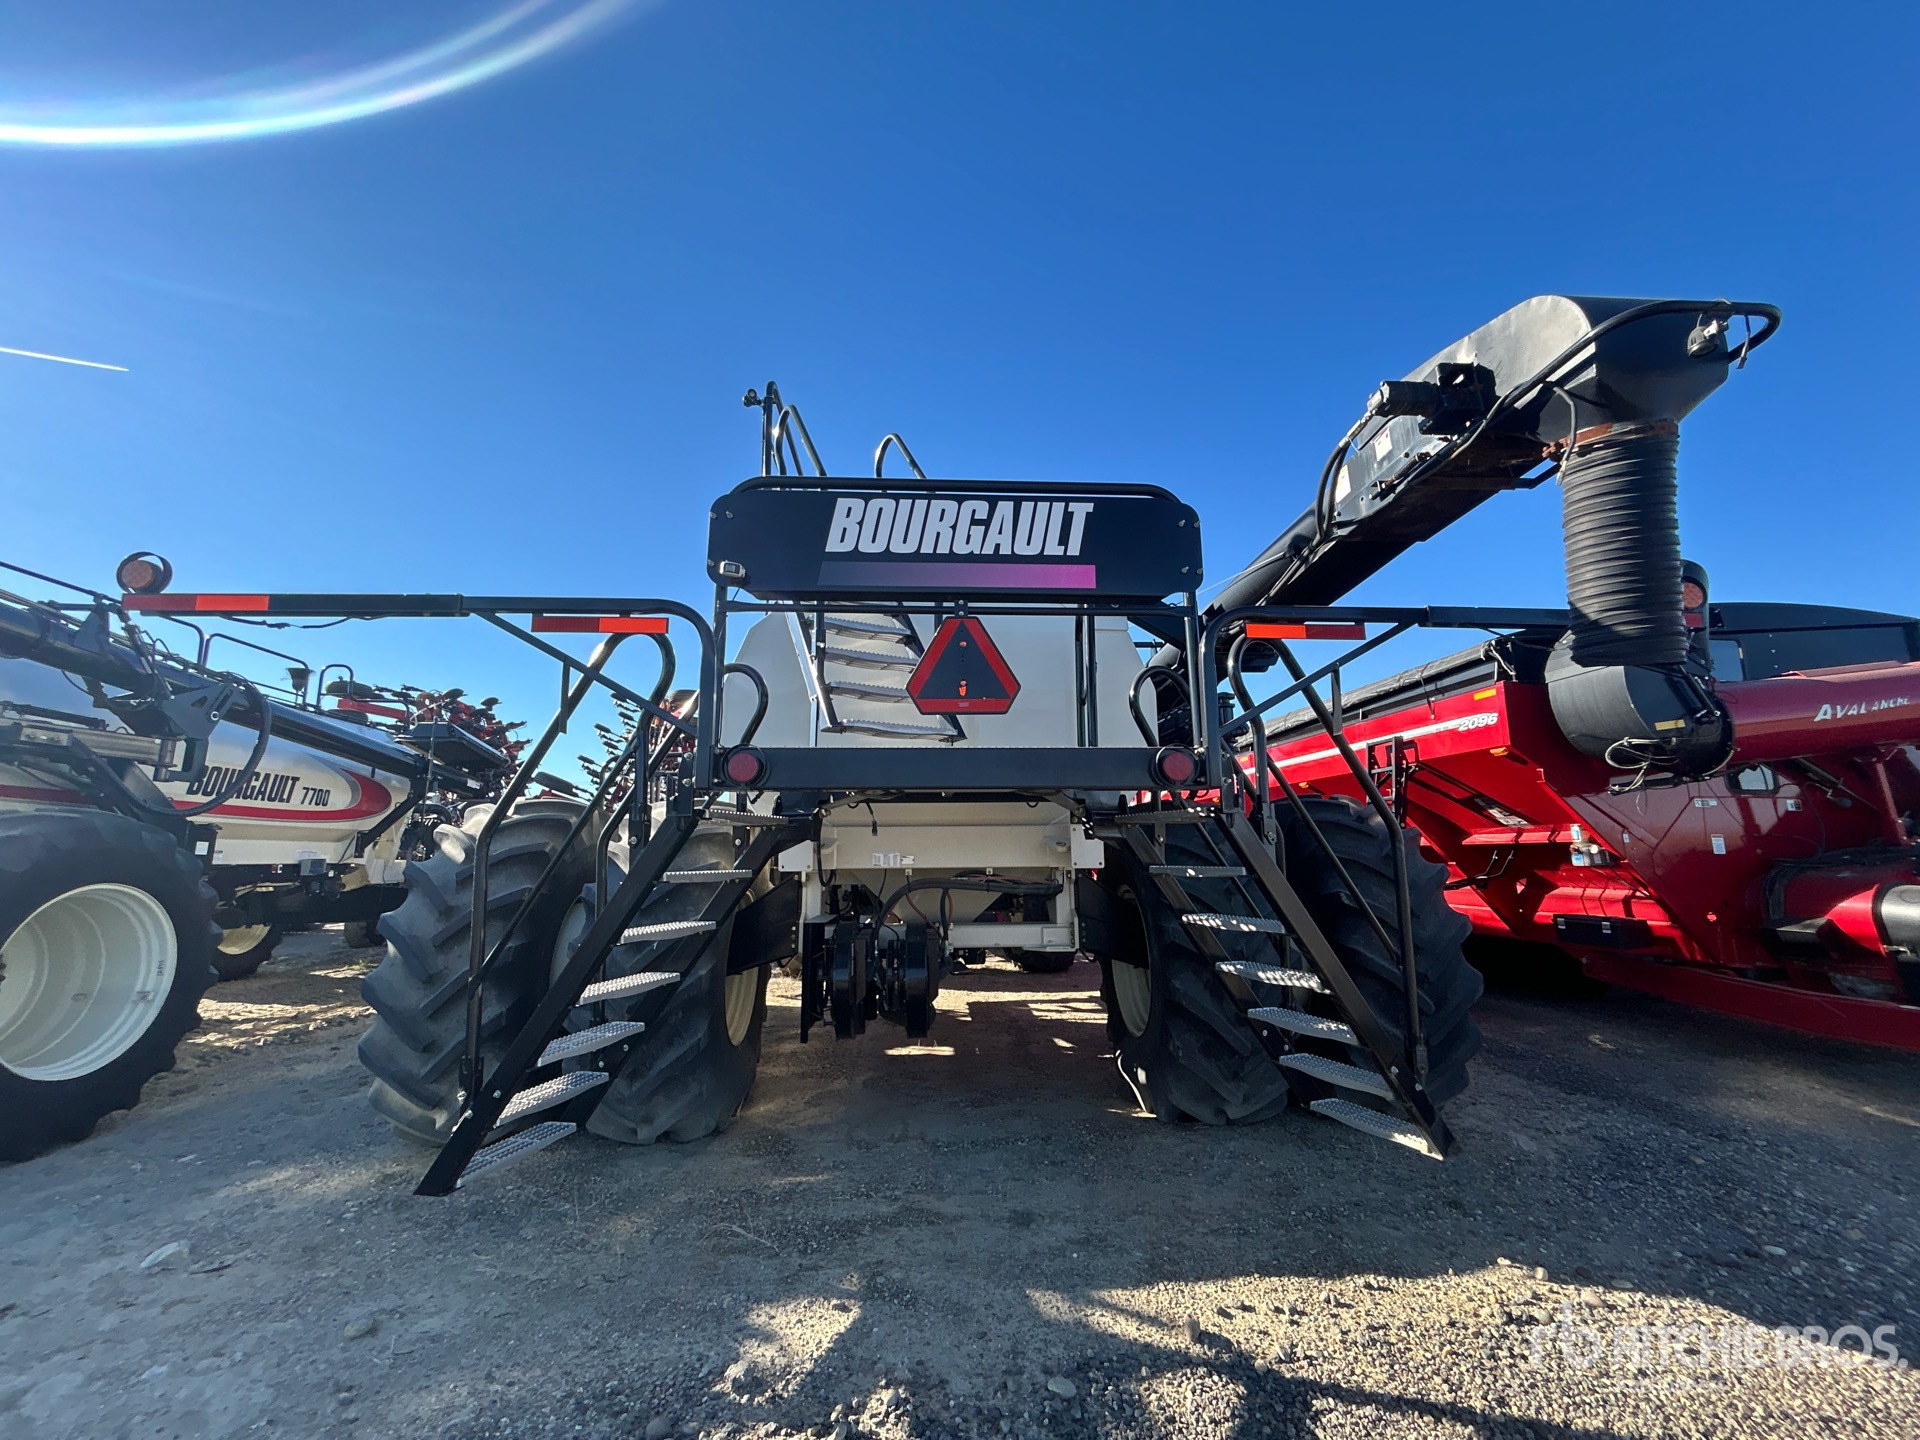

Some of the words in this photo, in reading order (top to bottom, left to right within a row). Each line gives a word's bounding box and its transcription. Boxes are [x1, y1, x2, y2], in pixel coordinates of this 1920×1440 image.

[825, 498, 1094, 556] BOURGAULT
[1457, 712, 1499, 732] 2096
[301, 786, 331, 807] 7700
